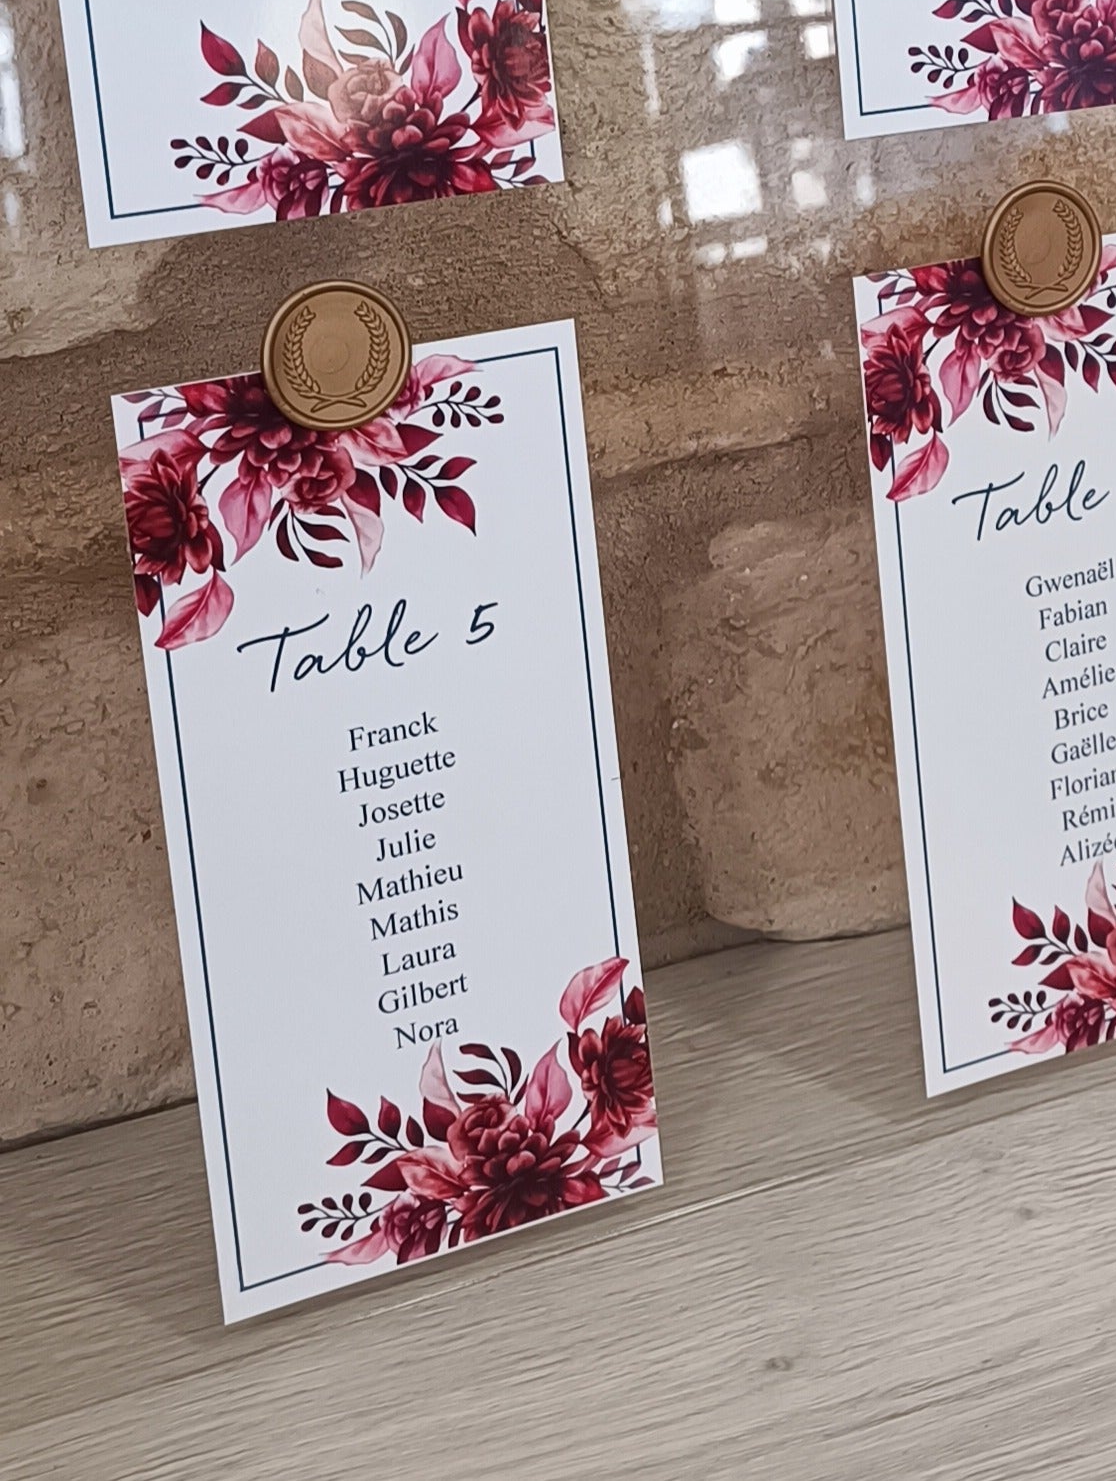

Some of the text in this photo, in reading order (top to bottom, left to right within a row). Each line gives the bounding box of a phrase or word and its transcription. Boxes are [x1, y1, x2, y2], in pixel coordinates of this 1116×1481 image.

[951, 459, 1110, 541] Table
[1025, 558, 1114, 597] Gwenaël
[1039, 599, 1108, 630] Fabian
[236, 599, 499, 693] Table 5
[1045, 633, 1107, 663] Claire
[1042, 663, 1116, 699] Amélie
[347, 711, 439, 753] Franck
[1054, 702, 1108, 730] Brice
[1051, 731, 1116, 765] Gaëlle
[337, 750, 456, 794] Huguette
[358, 788, 445, 828] Josette
[1062, 797, 1115, 832] Rémi
[376, 828, 436, 862] Julie
[356, 864, 463, 906] Mathieu
[369, 899, 459, 941] Mathis
[381, 942, 457, 977] Laura
[378, 973, 468, 1014] Gilbert
[393, 1015, 459, 1050] Nora
